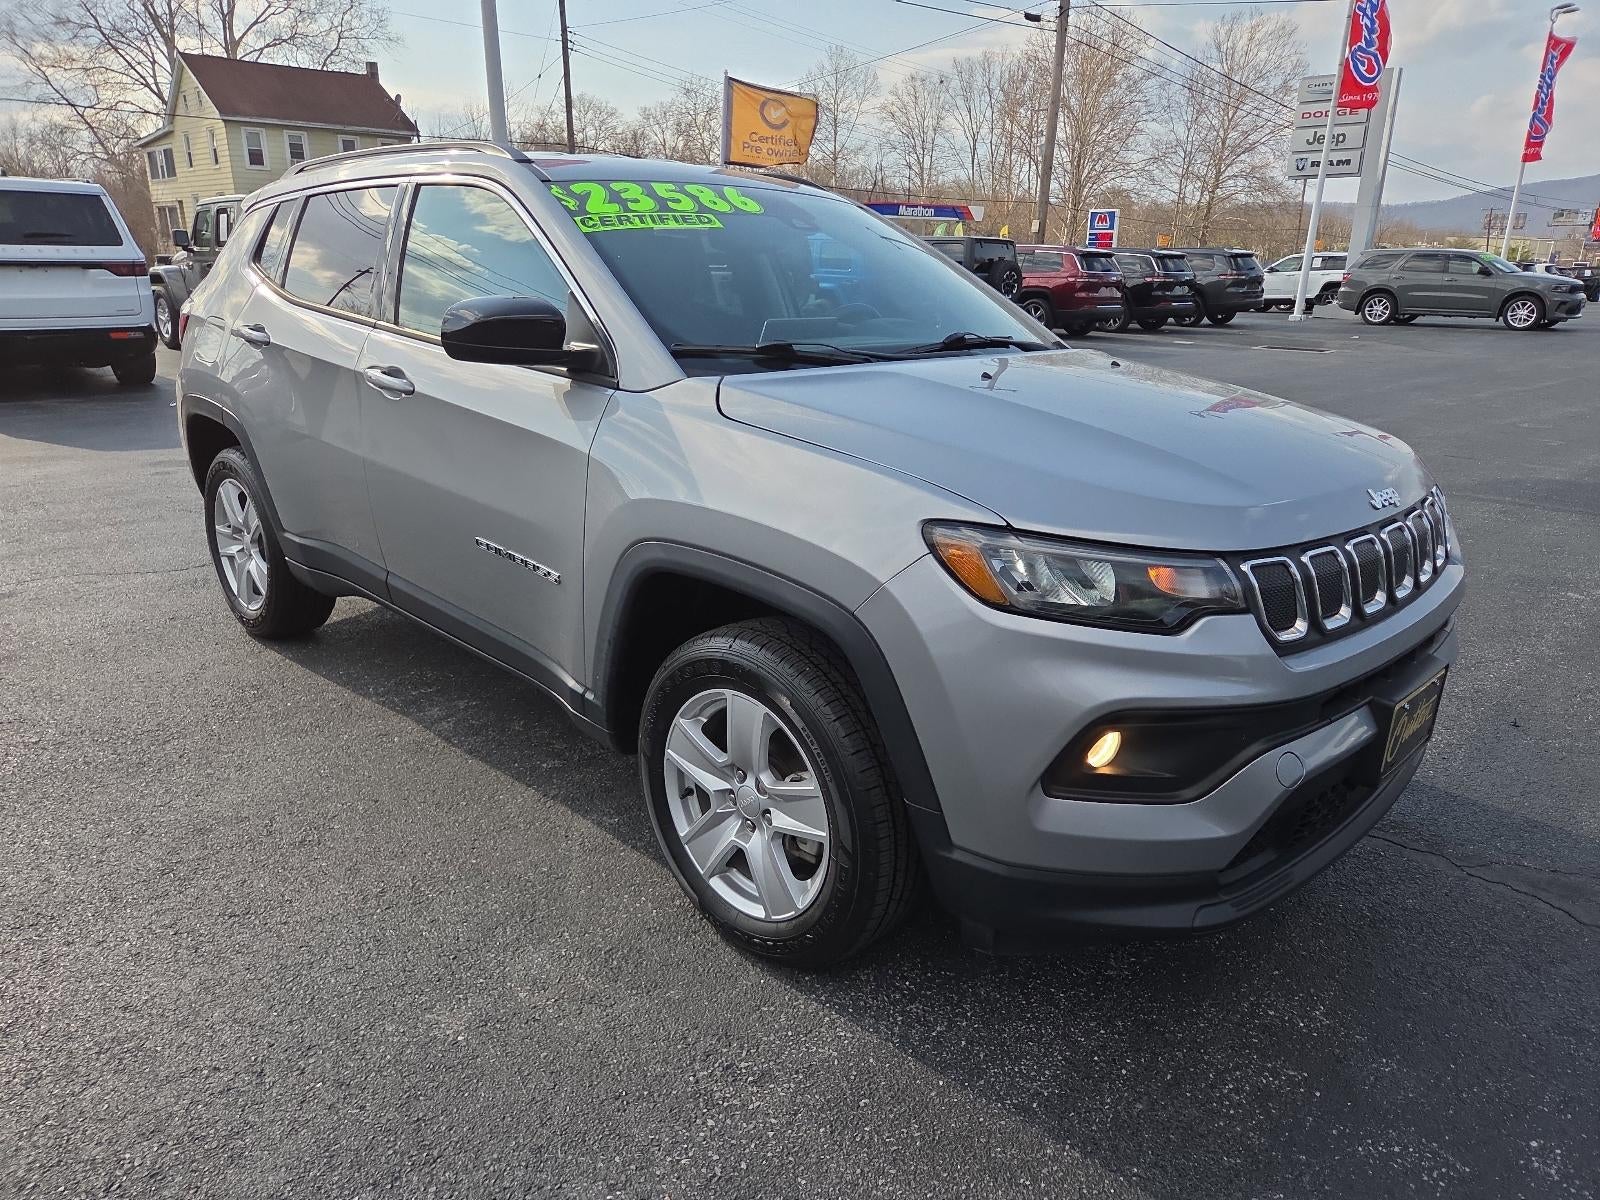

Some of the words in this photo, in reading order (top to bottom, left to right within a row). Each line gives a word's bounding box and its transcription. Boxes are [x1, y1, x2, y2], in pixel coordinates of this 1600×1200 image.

[742, 141, 762, 154] Pre
[898, 204, 935, 217] Marathon
[579, 214, 715, 229] CERTIFIED
[1367, 487, 1401, 510] Jeep
